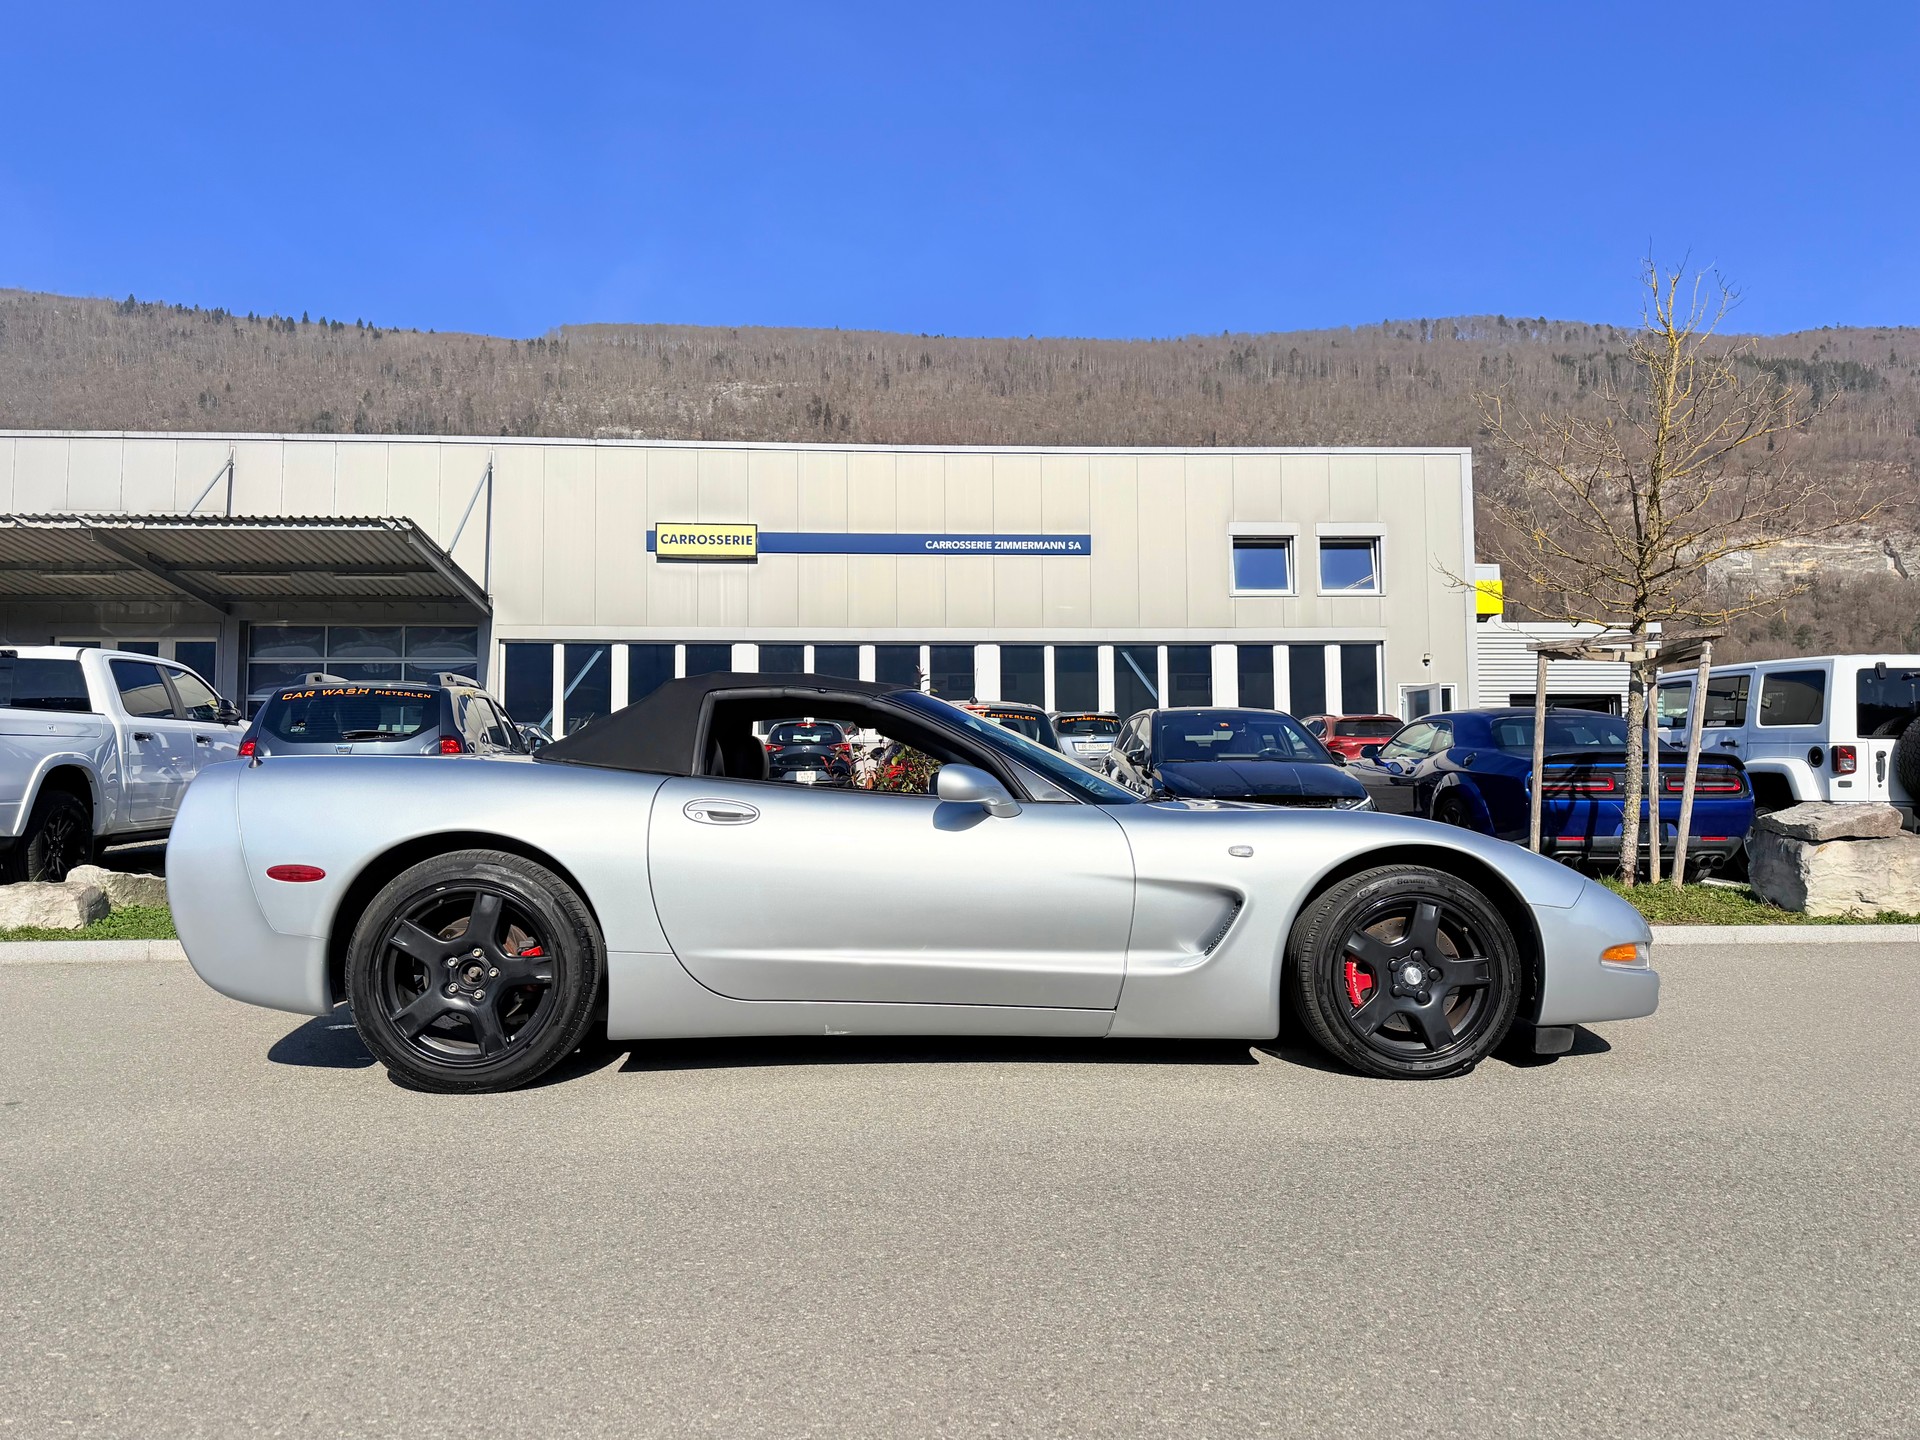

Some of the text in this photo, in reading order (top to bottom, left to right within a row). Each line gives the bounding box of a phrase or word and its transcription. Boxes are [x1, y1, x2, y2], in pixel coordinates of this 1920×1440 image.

[660, 533, 753, 546] CARROSSERIE
[925, 540, 1082, 550] CARROSSERIE ZIMMERMANN SA
[282, 688, 432, 700] CAR WASH PIETERLEN
[990, 713, 1036, 721] PIETERLEN
